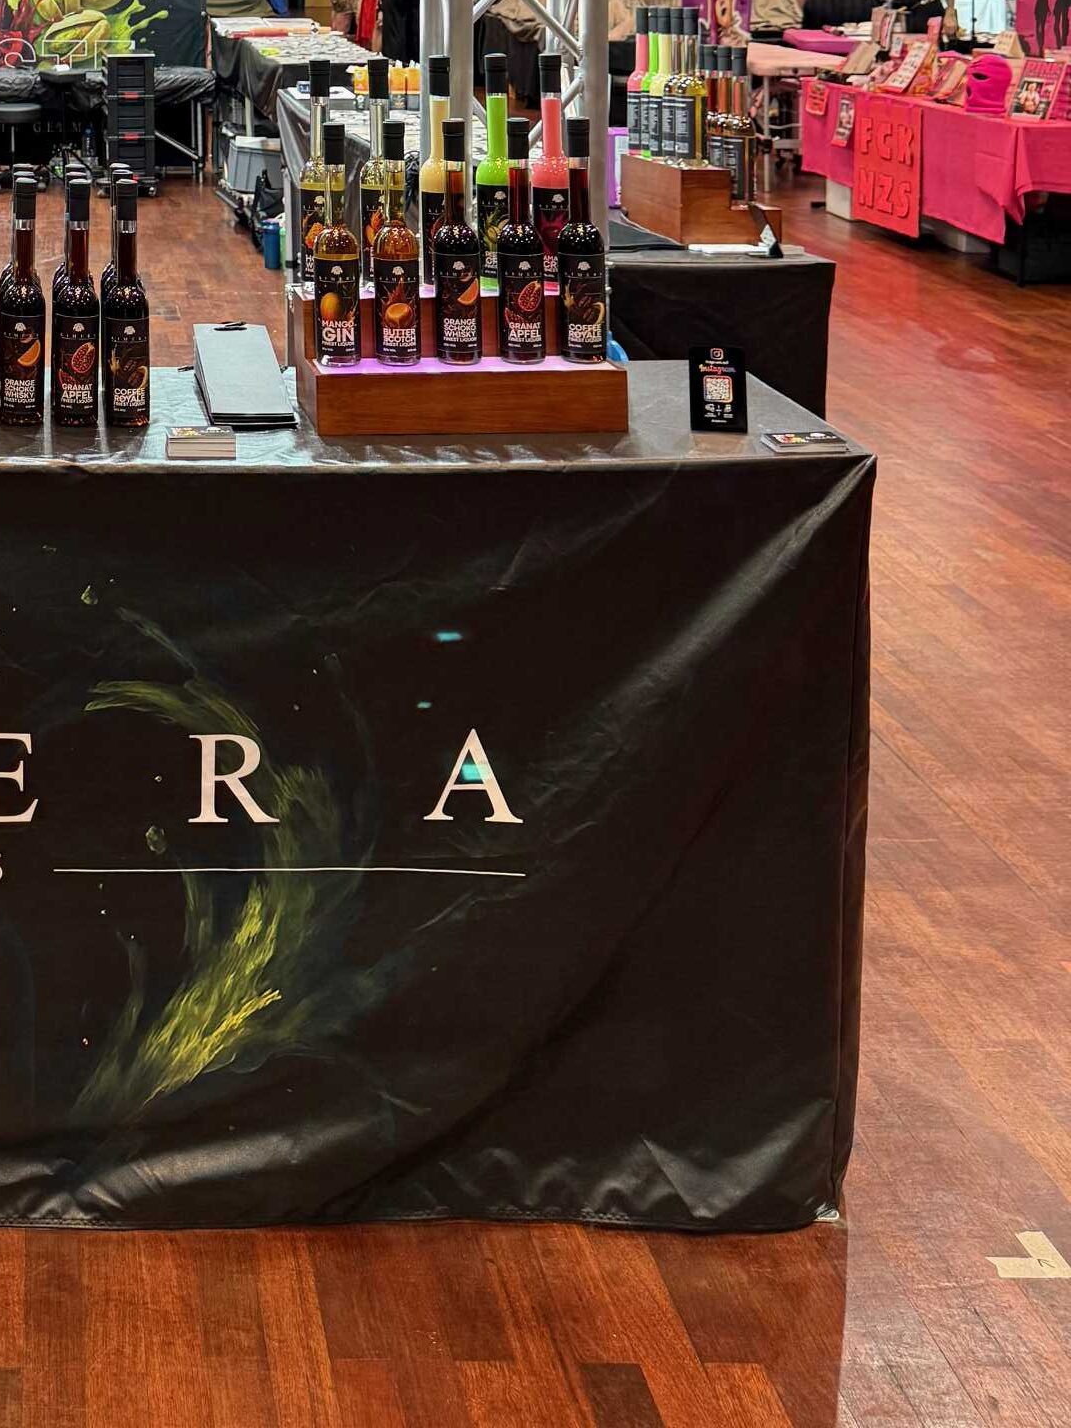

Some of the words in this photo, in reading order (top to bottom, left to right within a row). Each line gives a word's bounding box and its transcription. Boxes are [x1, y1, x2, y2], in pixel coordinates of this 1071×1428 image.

[860, 117, 915, 168] FCK
[857, 168, 912, 219] NZS
[322, 320, 354, 328] MANGO
[568, 323, 602, 331] COFFEE
[322, 328, 355, 342] GIN
[383, 328, 416, 336] BUTTER
[509, 329, 541, 337] APFEL
[568, 330, 602, 338] ROYALE
[4, 378, 35, 386] ORANGE
[62, 391, 93, 399] APFEL
[114, 394, 145, 402] ROYALE
